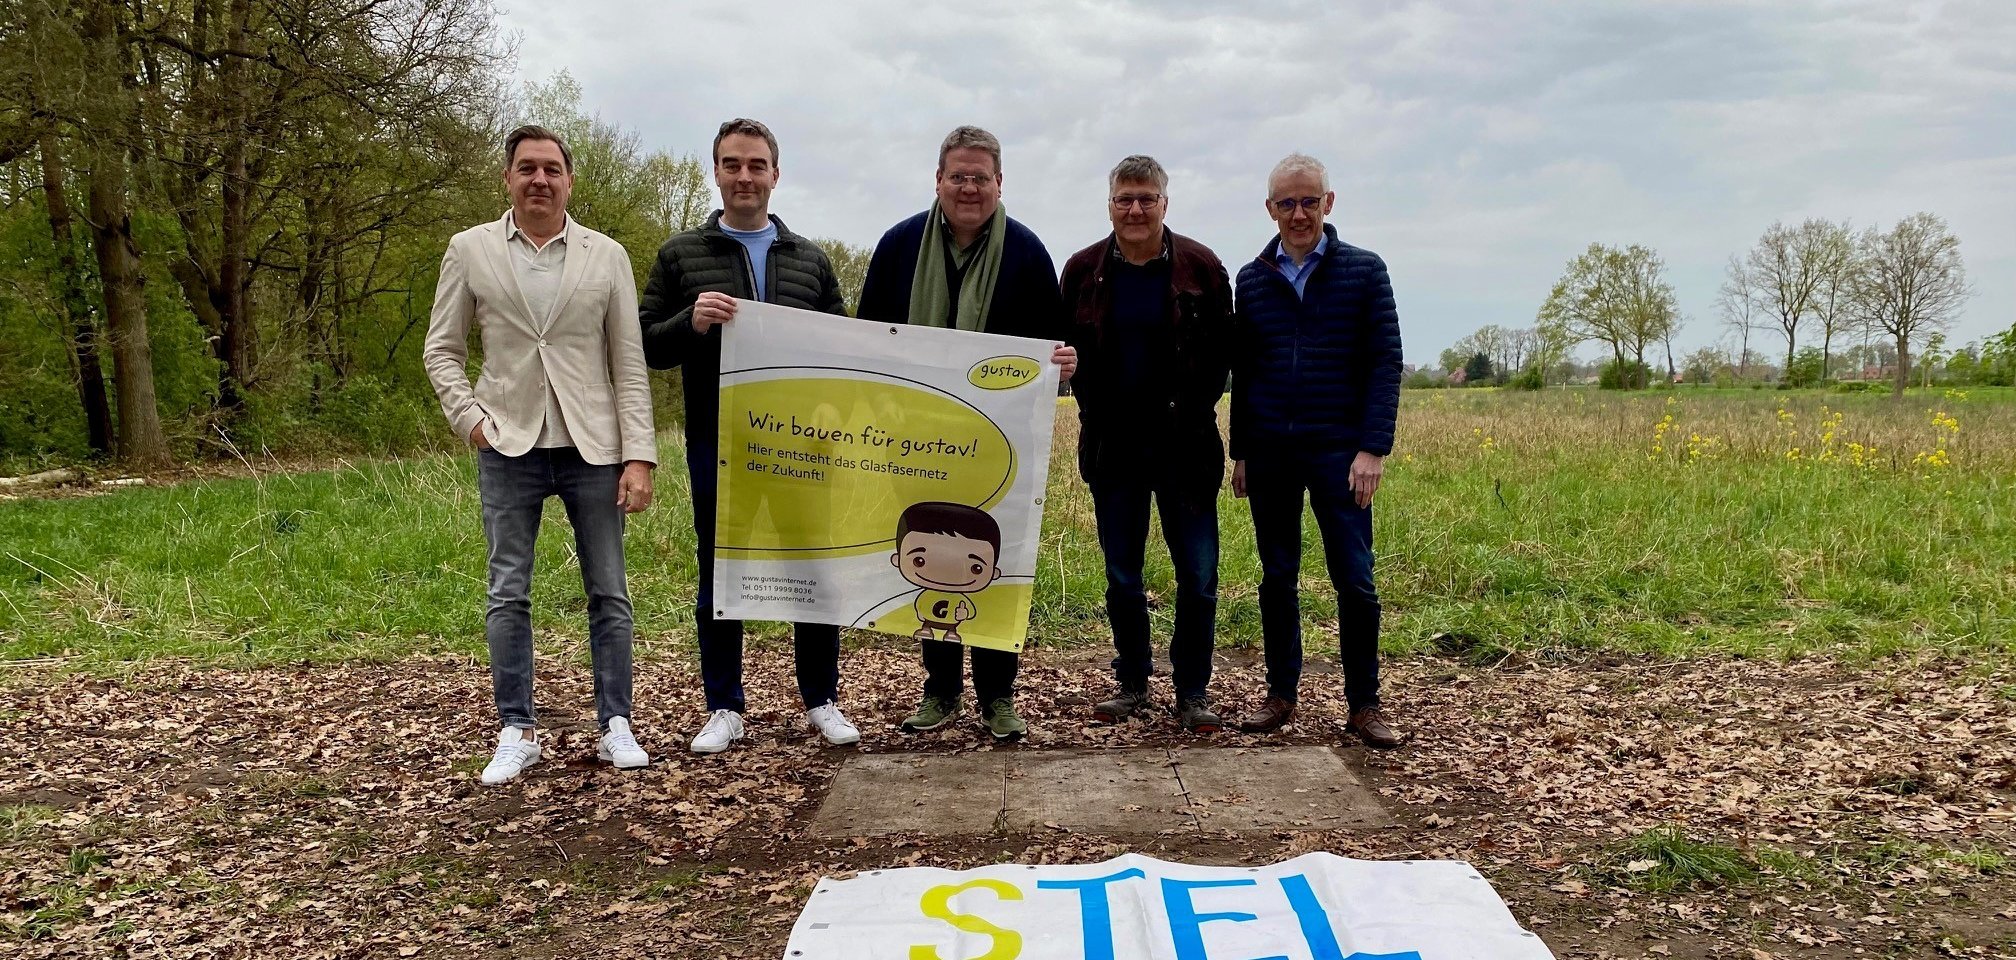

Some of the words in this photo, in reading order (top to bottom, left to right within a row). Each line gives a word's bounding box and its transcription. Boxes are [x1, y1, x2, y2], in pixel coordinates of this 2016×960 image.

[980, 363, 1030, 379] gustav
[748, 410, 785, 433] Wir
[791, 415, 854, 445] bauen
[861, 425, 895, 448] für
[900, 438, 978, 458] gustav!
[747, 442, 773, 456] Hier
[777, 449, 831, 466] entsteht
[834, 456, 856, 469] das
[860, 459, 948, 481] Glasfasernetz
[747, 459, 768, 472] der
[772, 463, 824, 481] Zukunft!
[741, 575, 817, 586] www.gustavinternet.de
[753, 584, 772, 592] 0511
[773, 585, 793, 593] 9999
[793, 587, 813, 595] 8036
[932, 600, 949, 619] G
[908, 867, 1423, 960] STEL
